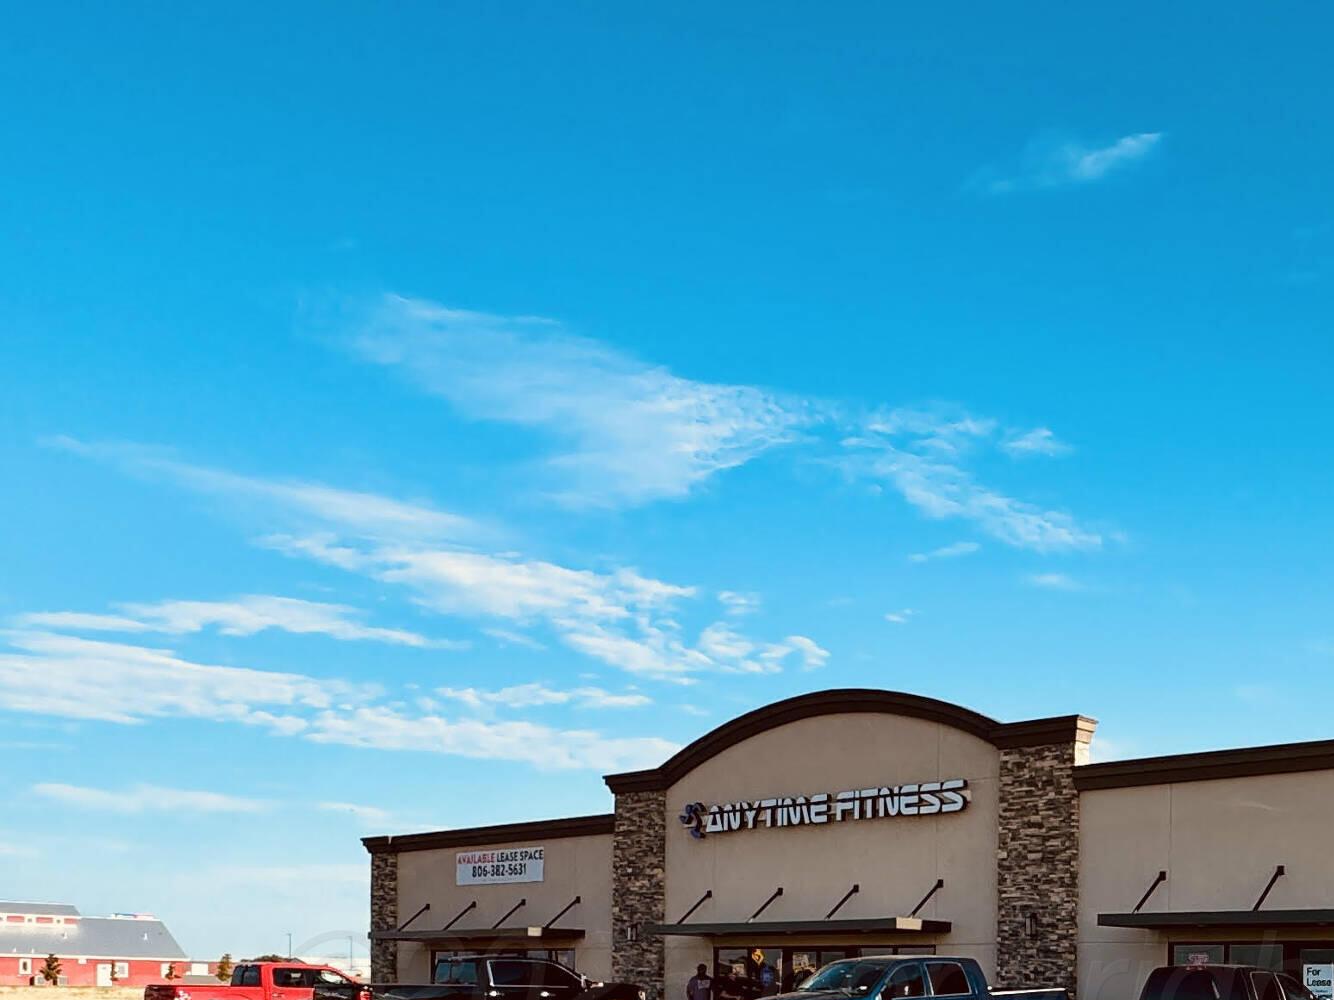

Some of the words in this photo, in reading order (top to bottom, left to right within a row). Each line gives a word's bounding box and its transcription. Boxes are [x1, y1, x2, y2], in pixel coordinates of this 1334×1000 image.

[705, 793, 830, 834] ANYTIME
[835, 778, 968, 823] FITNESS
[457, 852, 496, 865] AVAILABLE
[496, 850, 519, 863] LEASE
[519, 849, 544, 861] SPACE
[472, 863, 527, 878] 806-382-5631
[1306, 967, 1321, 976] For
[1306, 977, 1332, 987] Lease
